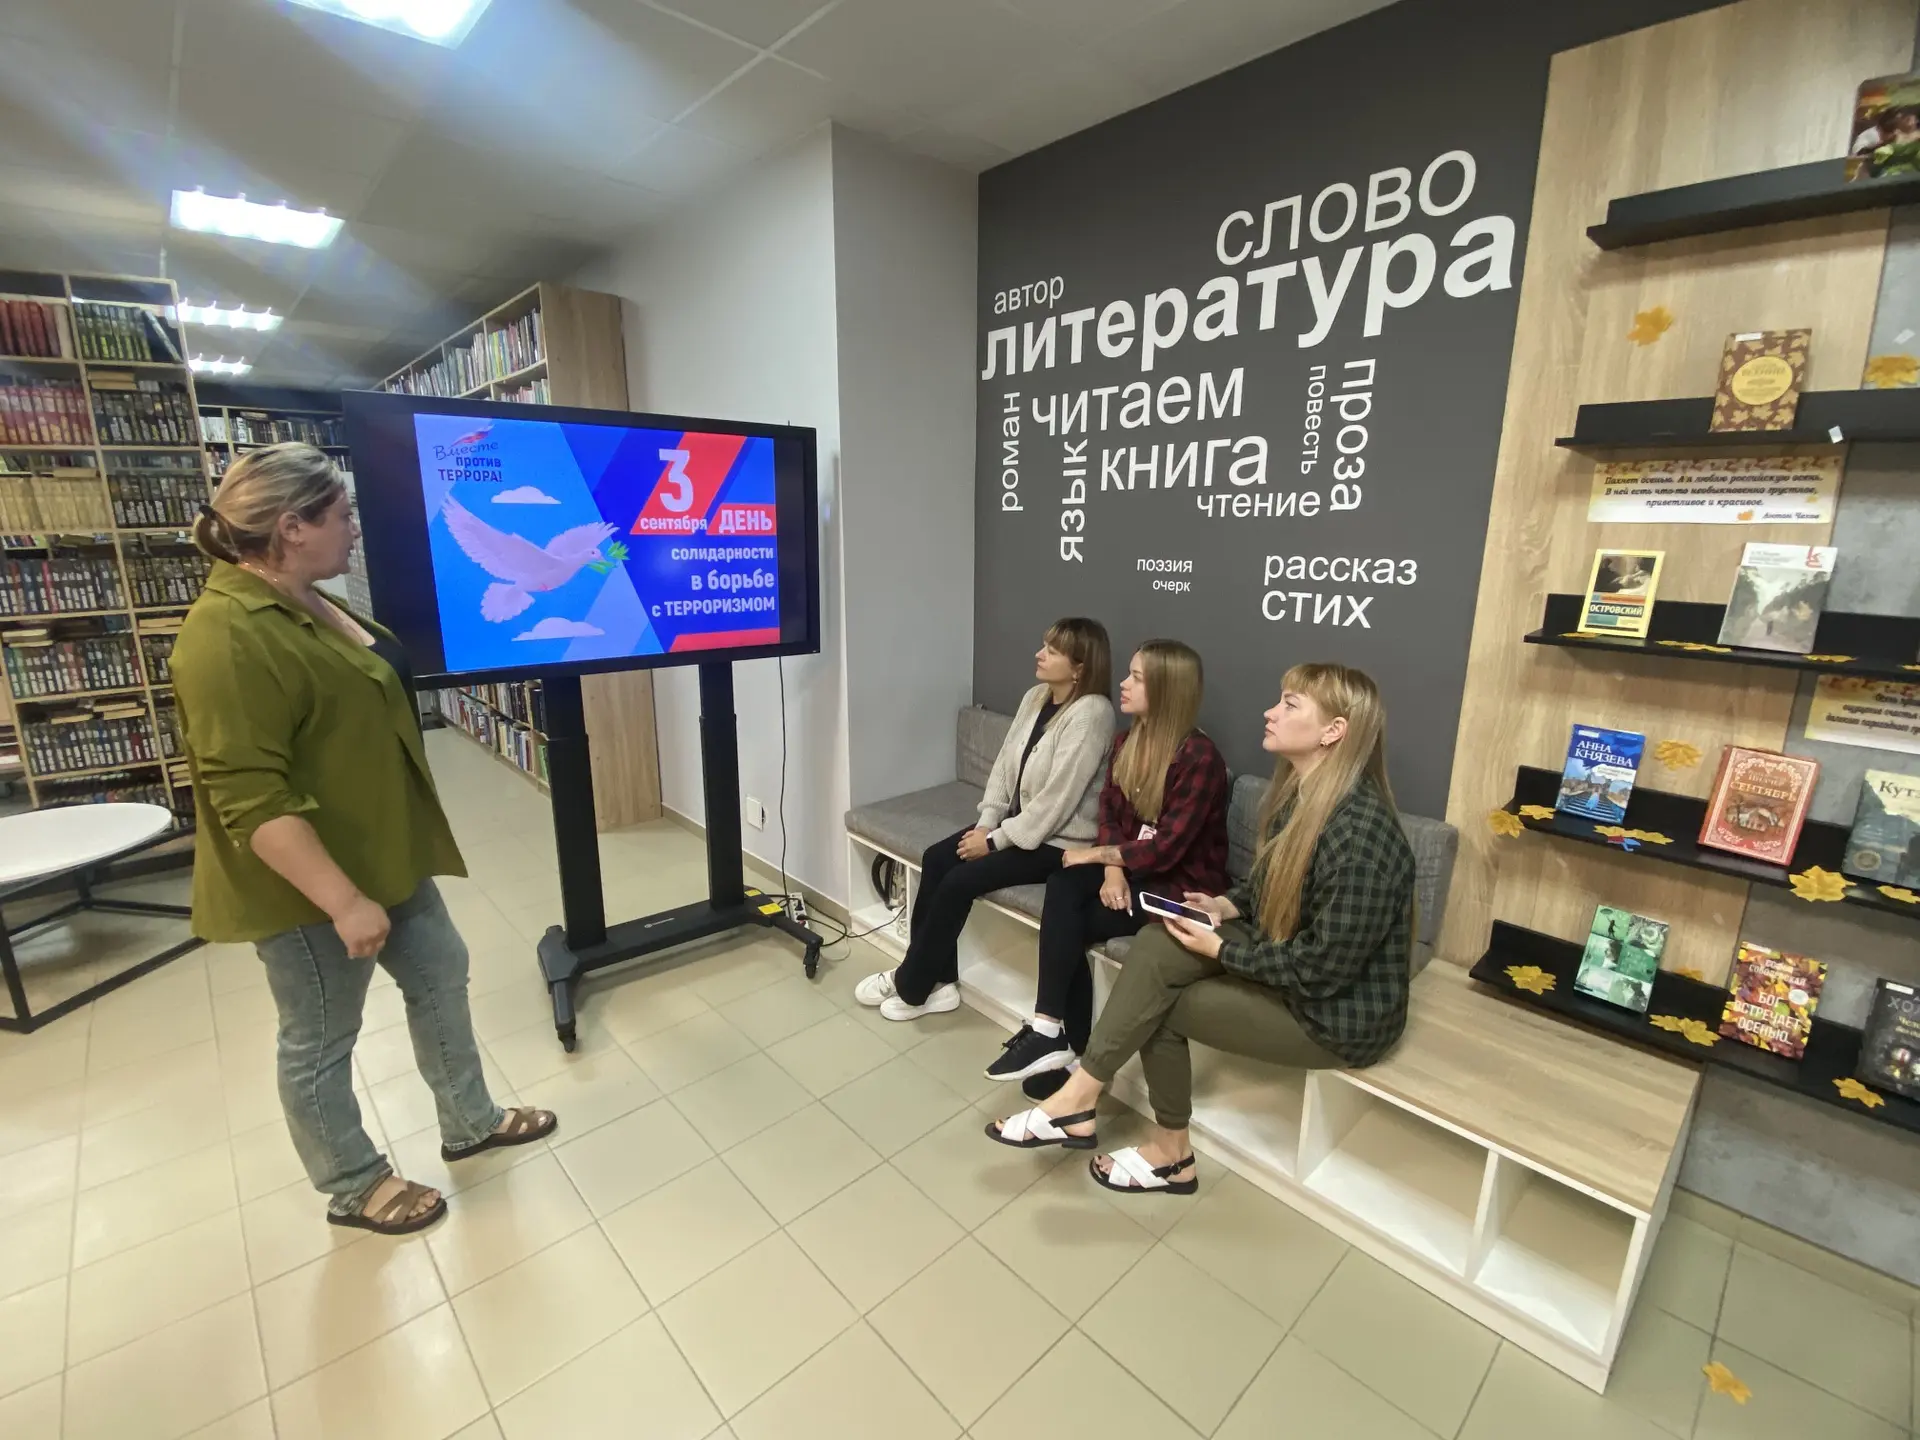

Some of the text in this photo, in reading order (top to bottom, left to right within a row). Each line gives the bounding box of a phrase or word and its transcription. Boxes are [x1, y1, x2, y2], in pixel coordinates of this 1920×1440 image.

[982, 216, 1516, 380] литература
[994, 275, 1064, 314] автор
[1032, 367, 1245, 436] читаем
[1300, 365, 1327, 475] повесть
[1330, 358, 1376, 512] проза
[433, 442, 499, 461] Вместе
[456, 456, 502, 469] против
[1002, 391, 1024, 512] роман
[1100, 435, 1270, 492] книга
[437, 469, 503, 483] ТЕРРОРА!
[658, 448, 694, 513] 3
[1060, 438, 1088, 564] язык
[1196, 491, 1321, 518] чтение
[640, 515, 708, 534] сентября
[718, 509, 773, 534] ДЕНЬ
[671, 547, 774, 563] солидарности
[1136, 556, 1193, 574] поэзия
[691, 568, 775, 594] в борьбе
[1264, 555, 1418, 587] рассказ
[1152, 579, 1192, 595] очерк
[651, 596, 775, 618] с ТЕРРОРИЗМОМ
[1261, 590, 1374, 629] стих
[1589, 604, 1643, 616] ОСТРОВСКИЙ
[1574, 748, 1634, 768] КНЯЗЕВА
[1577, 740, 1612, 754] АННА
[1730, 781, 1797, 802] СЕНТЯБРЬ
